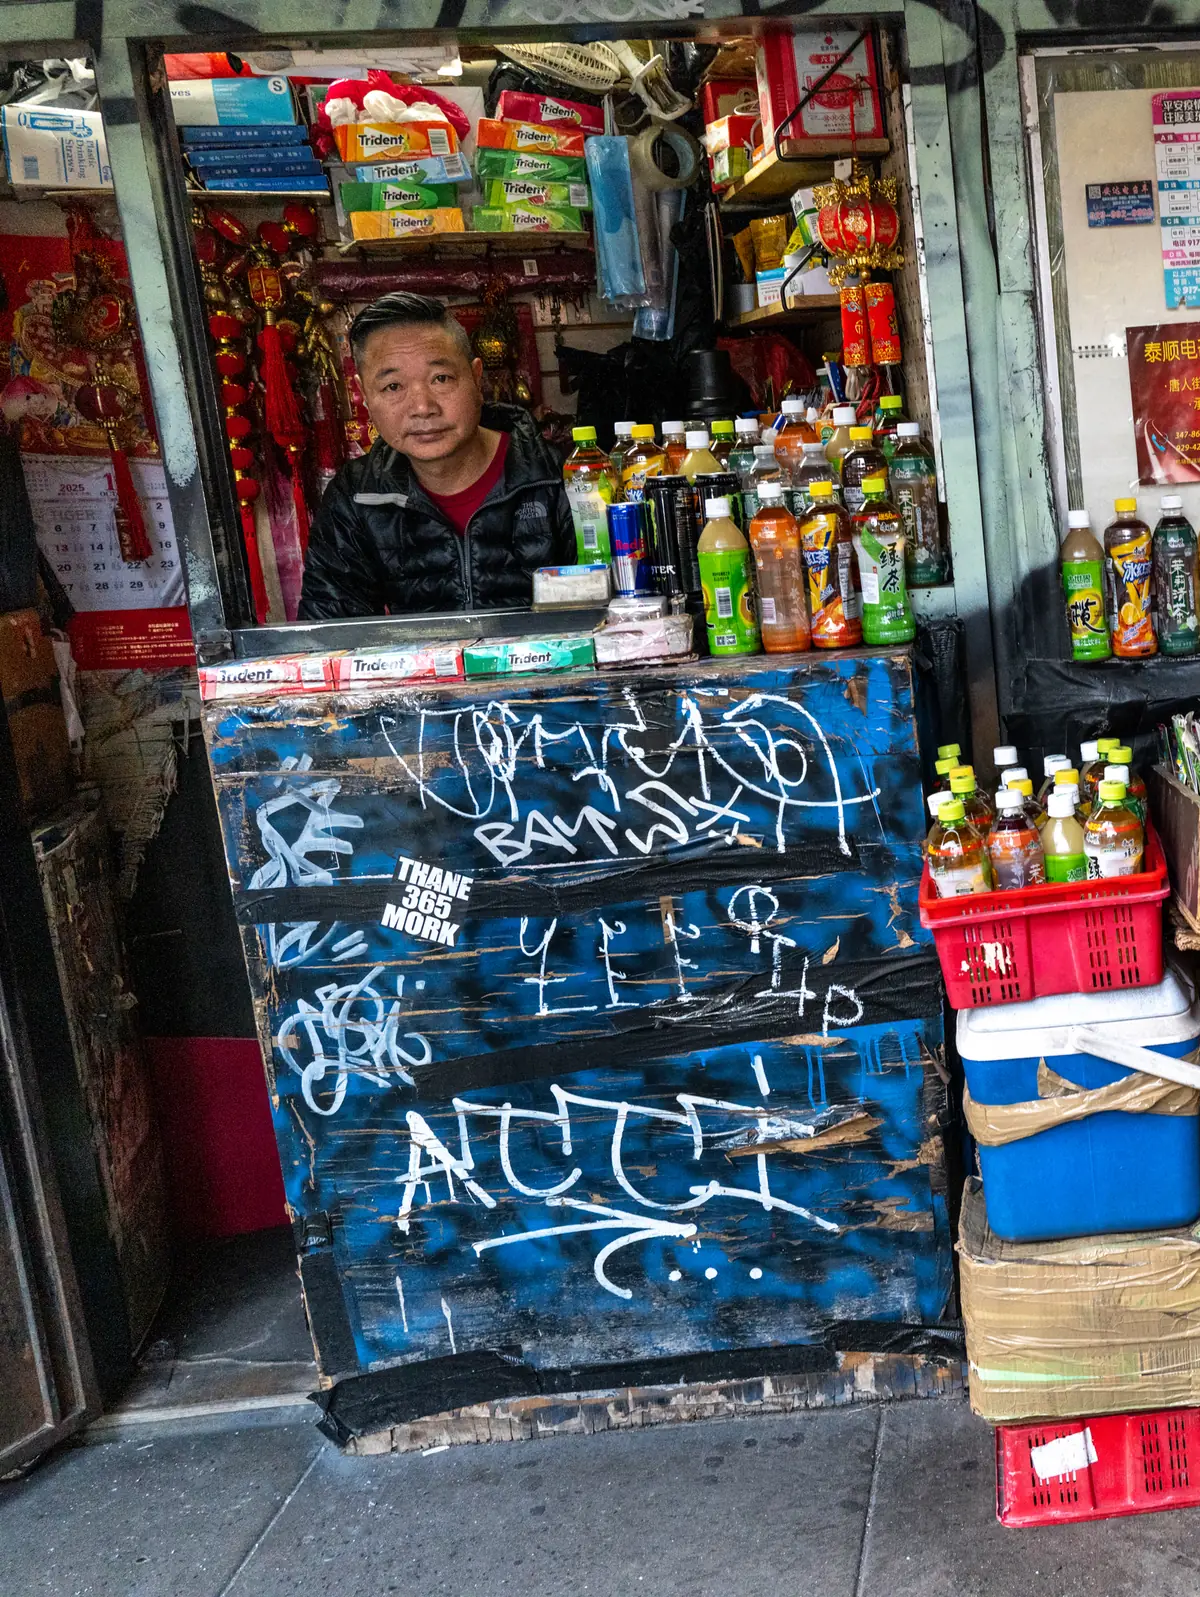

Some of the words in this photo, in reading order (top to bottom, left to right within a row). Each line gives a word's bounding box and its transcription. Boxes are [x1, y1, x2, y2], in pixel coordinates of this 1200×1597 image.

[273, 81, 282, 92] S
[541, 102, 575, 118] Trident
[358, 133, 404, 147] Trident
[516, 130, 551, 142] Trident
[65, 140, 75, 172] Straws
[76, 140, 85, 178] Drinking
[87, 140, 96, 168] Plastic
[515, 158, 551, 170] Trident
[374, 162, 419, 179] Trident
[504, 182, 547, 196] Trident
[382, 190, 420, 202] Trident
[391, 216, 429, 228] Trident
[512, 213, 547, 225] Trident
[60, 484, 85, 493] 2025
[156, 502, 163, 510] 2
[159, 522, 165, 530] 9
[56, 544, 68, 552] 13
[90, 543, 104, 551] 14
[159, 541, 172, 549] 16
[616, 540, 637, 550] Red
[57, 564, 72, 572] 20
[93, 563, 106, 571] 21
[127, 562, 141, 570] 22
[161, 560, 174, 568] 23
[880, 542, 903, 594] 绿茶
[95, 582, 109, 590] 28
[130, 581, 143, 589] 29
[354, 656, 406, 673] Trident
[508, 652, 551, 665] Trident
[397, 856, 476, 902] THANE
[401, 884, 453, 920] 365
[380, 902, 461, 948] MORK
